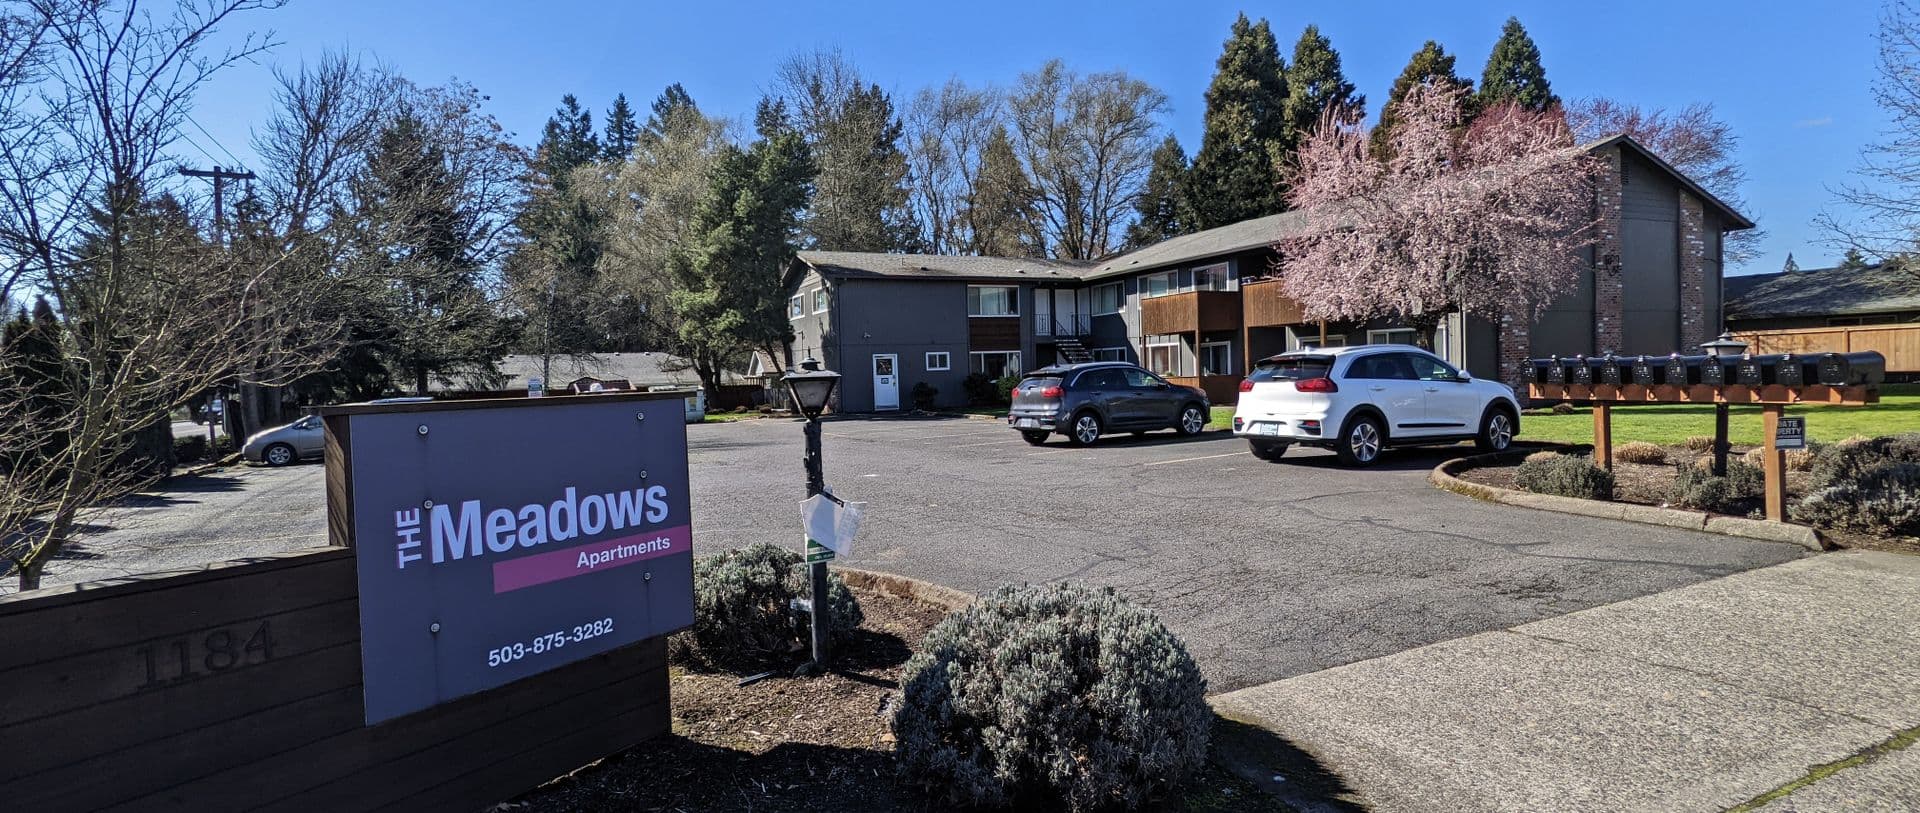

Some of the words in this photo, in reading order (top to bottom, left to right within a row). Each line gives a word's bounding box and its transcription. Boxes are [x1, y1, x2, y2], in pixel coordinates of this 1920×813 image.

[395, 507, 421, 569] THE
[429, 484, 669, 564] Meadows
[576, 536, 671, 568] Apartments
[136, 620, 276, 690] 1184
[487, 617, 614, 668] 503-875-3282
